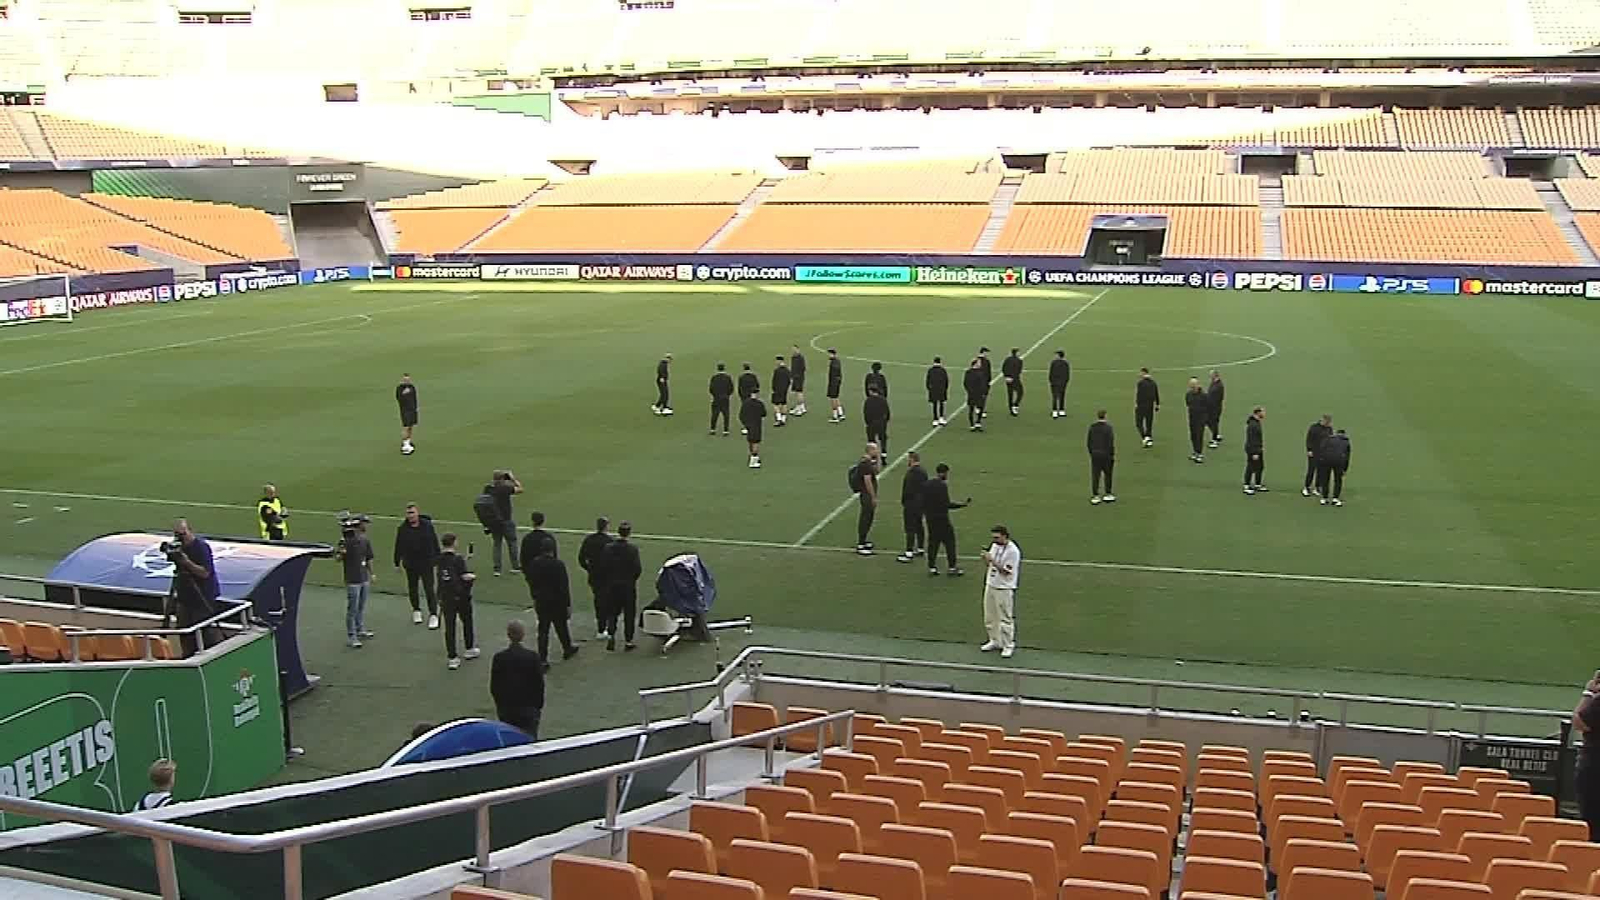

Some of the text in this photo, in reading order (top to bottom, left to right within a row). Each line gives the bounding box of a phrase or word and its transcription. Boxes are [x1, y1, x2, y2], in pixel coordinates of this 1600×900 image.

[413, 267, 480, 278] mastercard
[514, 268, 569, 276] HYUNDAI
[581, 266, 621, 278] QATAR
[623, 266, 675, 278] AIRWAYS
[711, 266, 791, 280] crypto.com
[916, 267, 1001, 284] Heineken
[1045, 272, 1186, 285] UEFA CHAMPIONS LEAGUE
[1234, 273, 1303, 291] PEPSI
[1485, 281, 1584, 295] mastercard
[173, 280, 217, 300] PEPSI
